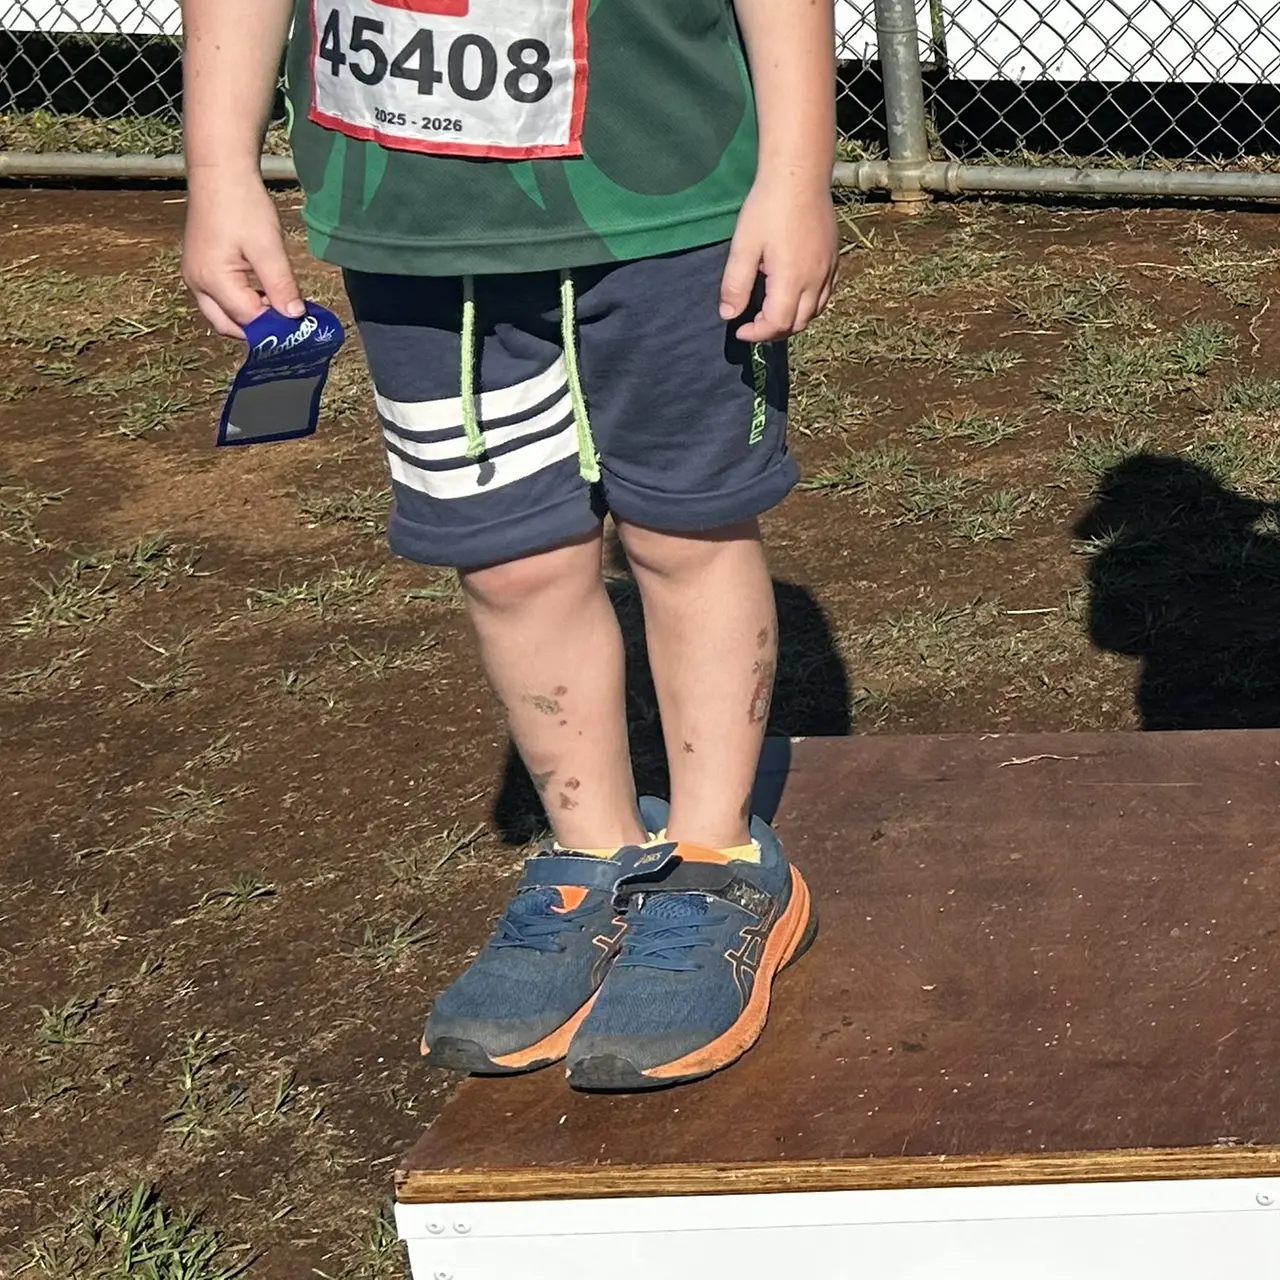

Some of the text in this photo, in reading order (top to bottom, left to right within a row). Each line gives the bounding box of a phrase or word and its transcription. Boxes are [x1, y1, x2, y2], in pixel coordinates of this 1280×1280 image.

[319, 8, 554, 104] 45408
[374, 107, 407, 126] 2025
[421, 117, 463, 132] 2026
[748, 395, 766, 445] CREW
